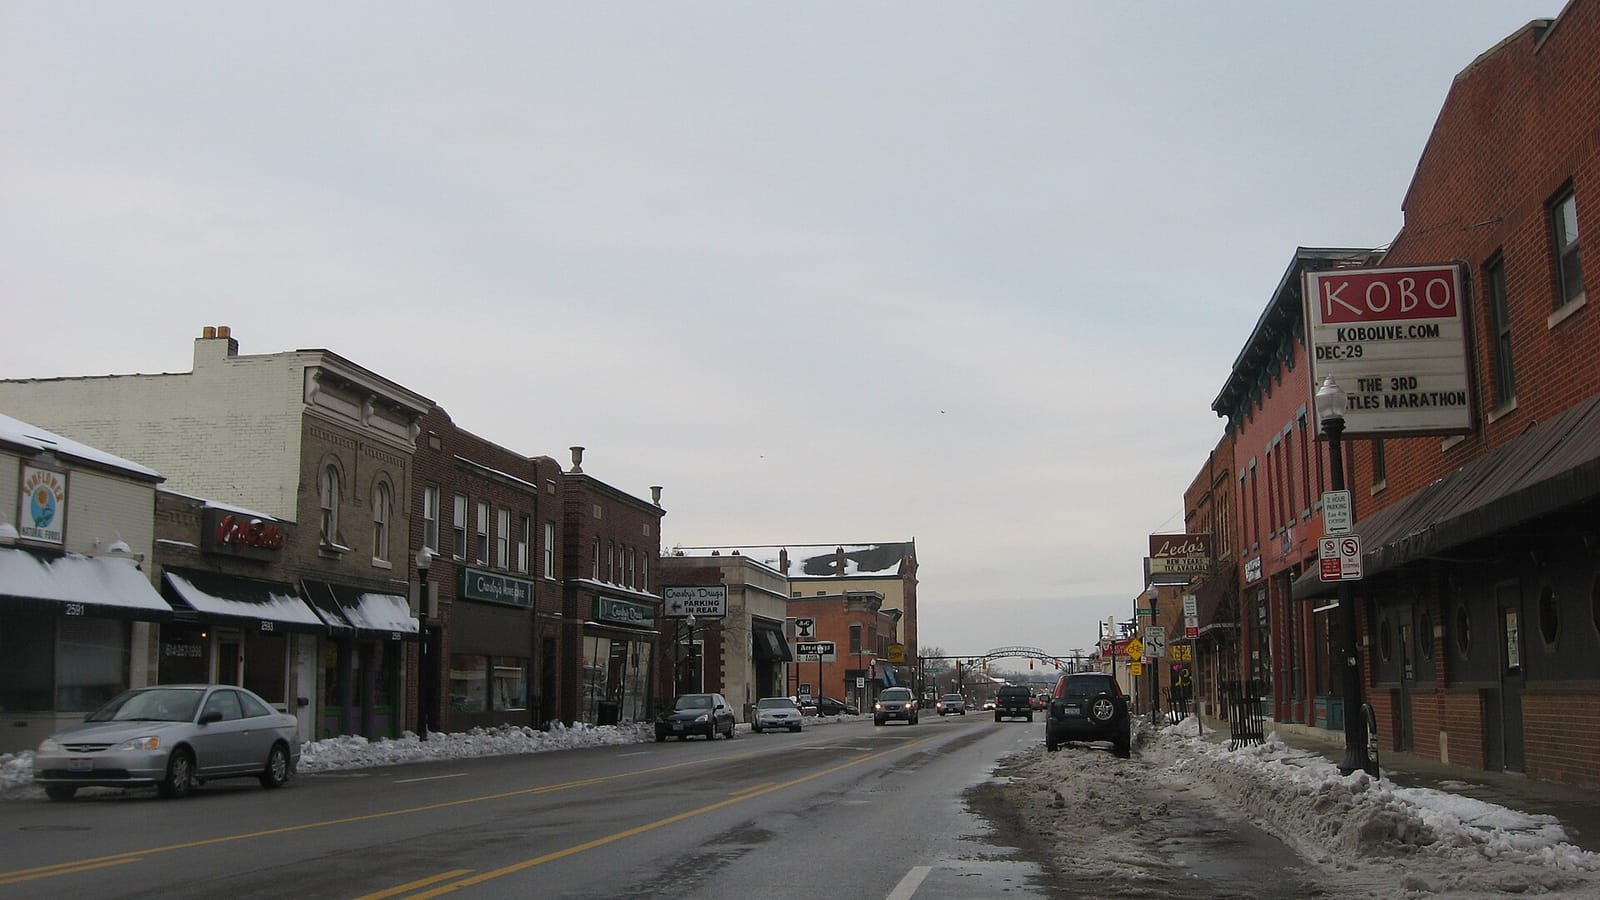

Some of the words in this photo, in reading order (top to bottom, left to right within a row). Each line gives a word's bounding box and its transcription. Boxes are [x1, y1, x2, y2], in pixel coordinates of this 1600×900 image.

[1324, 277, 1450, 317] KOBO
[1316, 345, 1363, 360] DEC-29
[1358, 378, 1383, 392] THE
[1391, 377, 1418, 391] 3RD
[1346, 394, 1380, 410] TLES
[1384, 391, 1467, 409] MARATHON
[24, 470, 64, 502] SUNFLOWER
[1332, 495, 1346, 503] HOUR
[22, 526, 43, 539] NATURAL
[45, 530, 60, 542] FOODS
[1154, 536, 1205, 558] Ledo's
[477, 576, 502, 599] Crosby's
[666, 588, 696, 600] Crosby's
[697, 588, 724, 600] Drugs
[66, 603, 85, 616] 2591
